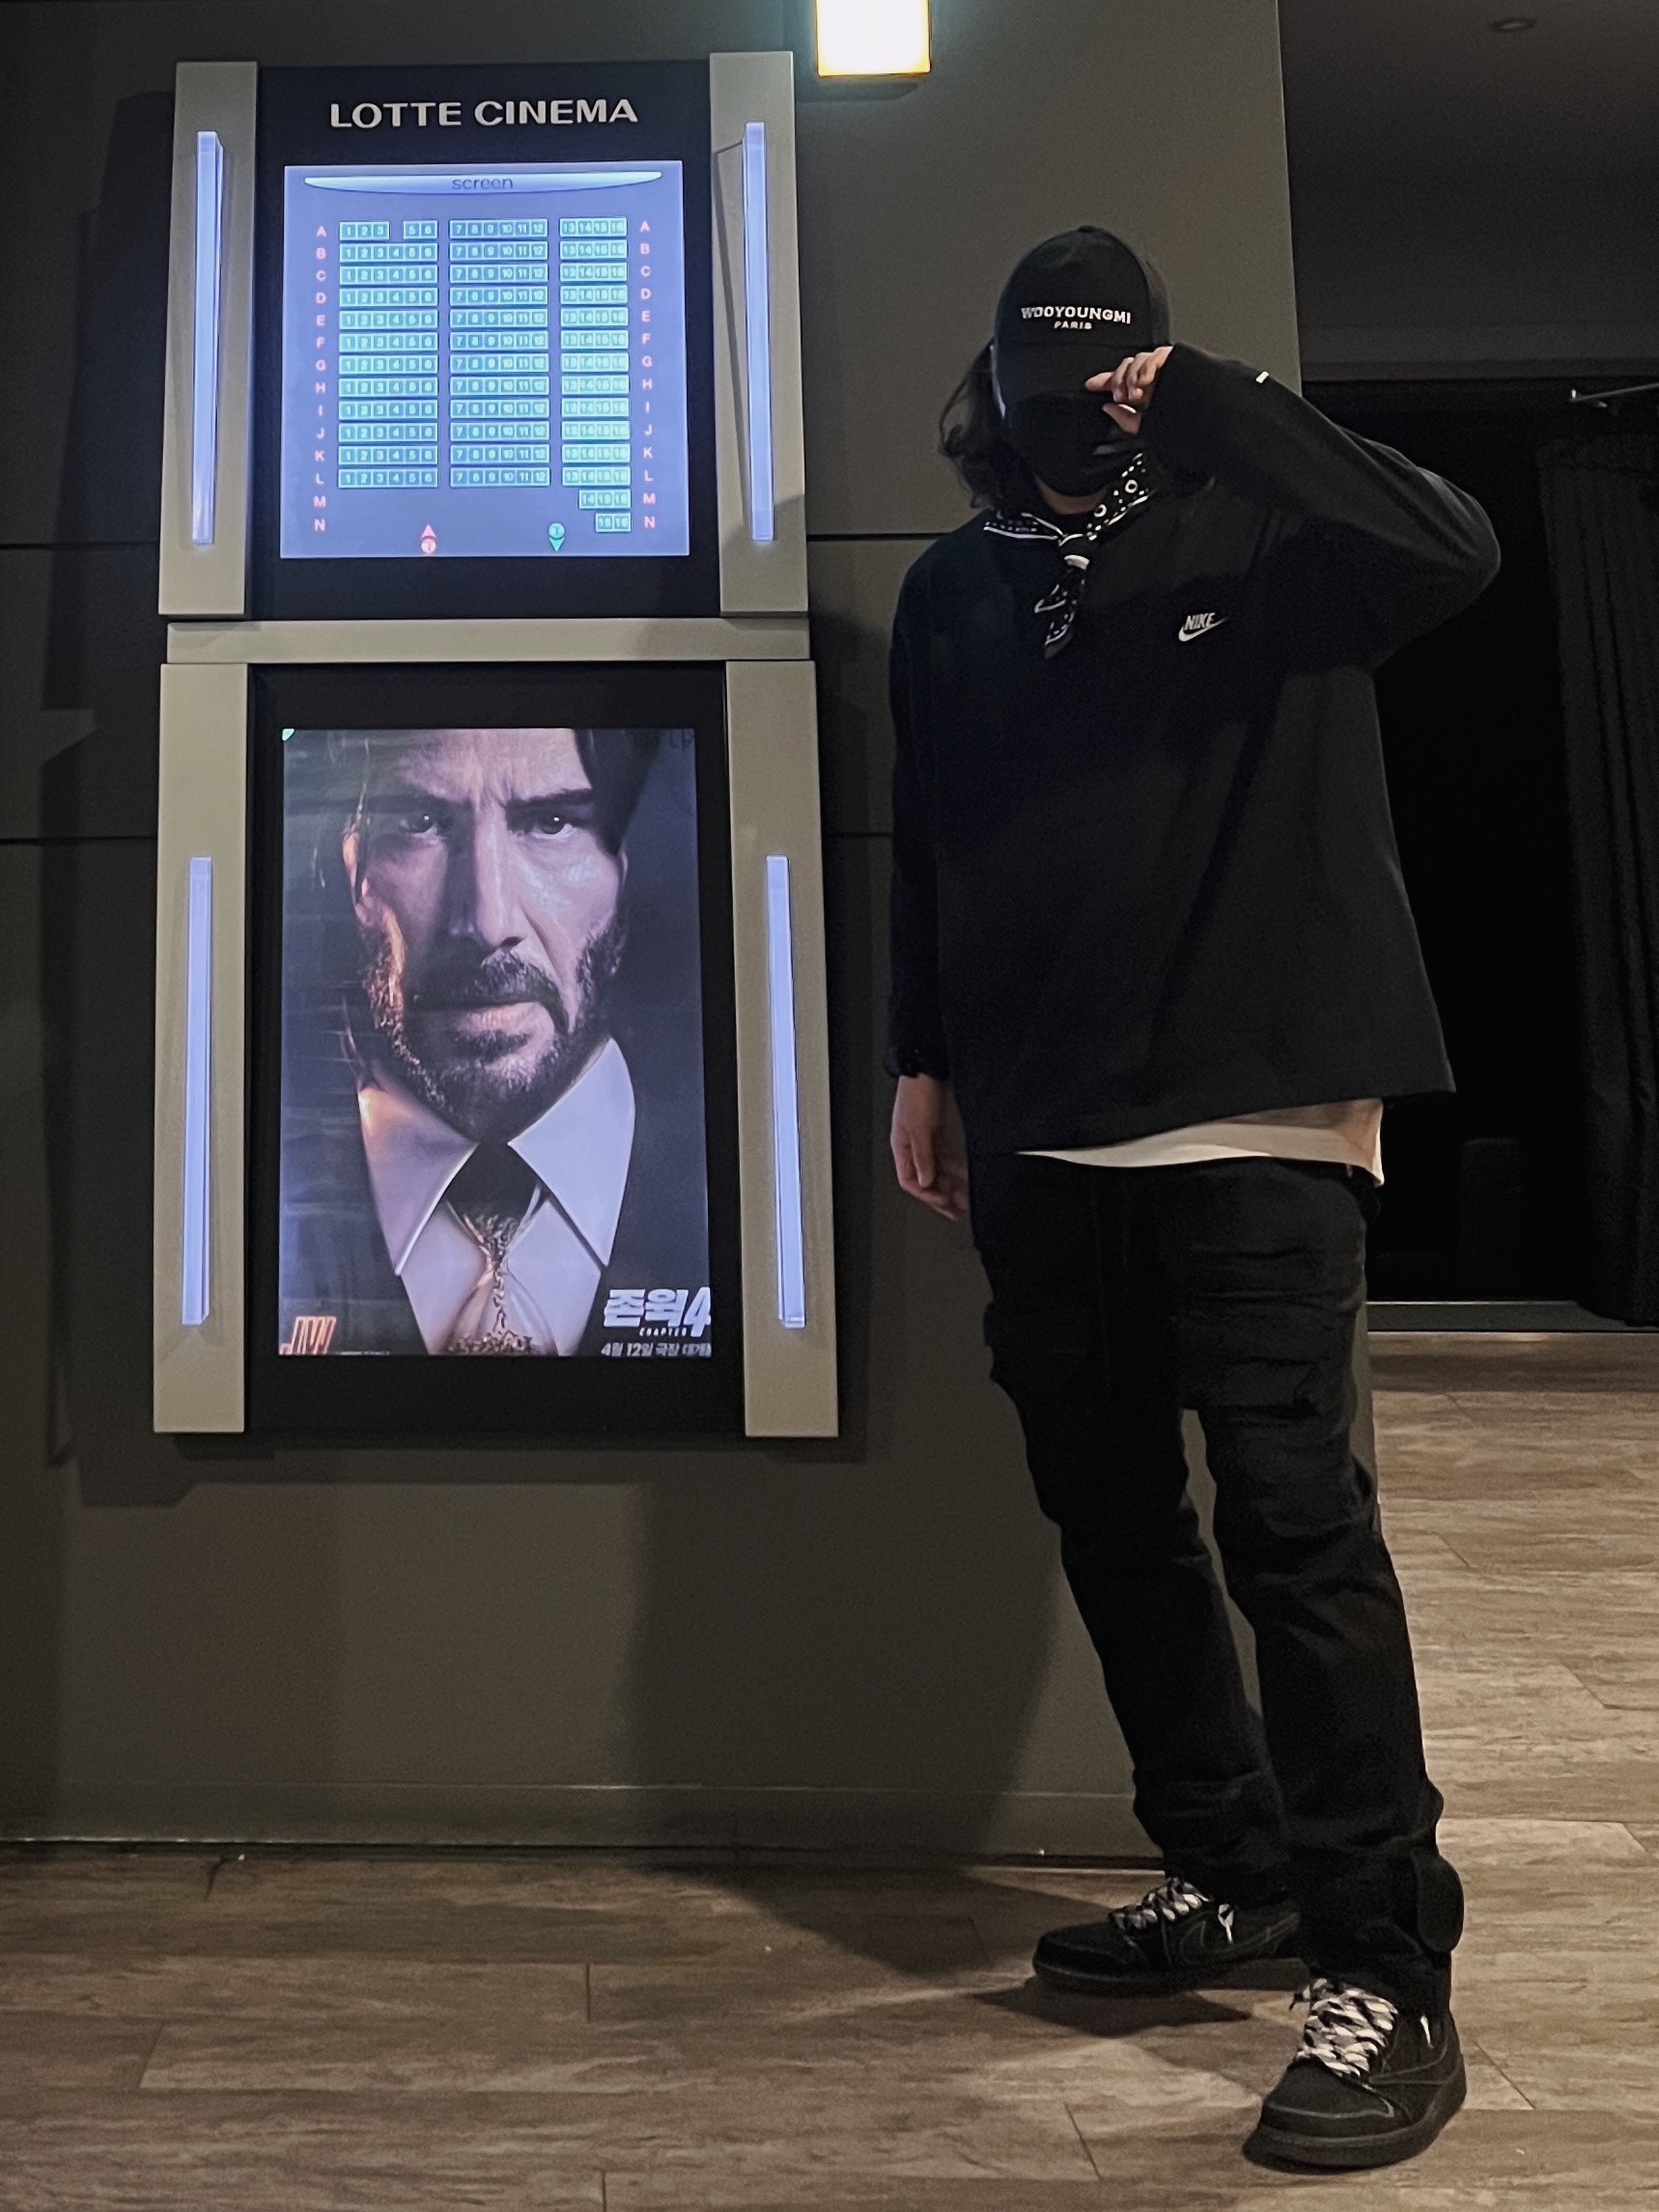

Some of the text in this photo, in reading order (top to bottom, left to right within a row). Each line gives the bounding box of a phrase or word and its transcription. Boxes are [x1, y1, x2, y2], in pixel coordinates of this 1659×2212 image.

[330, 98, 638, 128] LOTTE CINEMA
[451, 176, 514, 190] screen
[316, 225, 327, 238] A
[639, 220, 651, 233] A
[639, 242, 651, 255] B
[315, 269, 327, 282] C
[639, 265, 651, 277] C
[315, 292, 326, 304] D
[640, 288, 652, 300] D
[316, 314, 325, 326] E
[641, 310, 651, 322] E
[1021, 306, 1131, 323] WOOYOUNGMI
[1054, 321, 1092, 329] PARIS
[316, 336, 325, 349] F
[641, 332, 651, 345] F
[315, 359, 327, 372] G
[641, 355, 653, 368] G
[315, 381, 326, 394] H
[641, 378, 653, 390] H
[316, 427, 325, 439] J
[644, 424, 653, 436] J
[314, 450, 325, 462] K
[642, 446, 653, 459] K
[315, 473, 324, 486] L
[644, 469, 654, 483] L
[313, 495, 326, 508] M
[642, 492, 657, 505] M
[314, 518, 326, 531] N
[643, 516, 656, 529] N
[1183, 612, 1216, 630] NIKE
[604, 1286, 712, 1337] 존윅4
[601, 1342, 624, 1357] 4월
[626, 1342, 654, 1357] 12일
